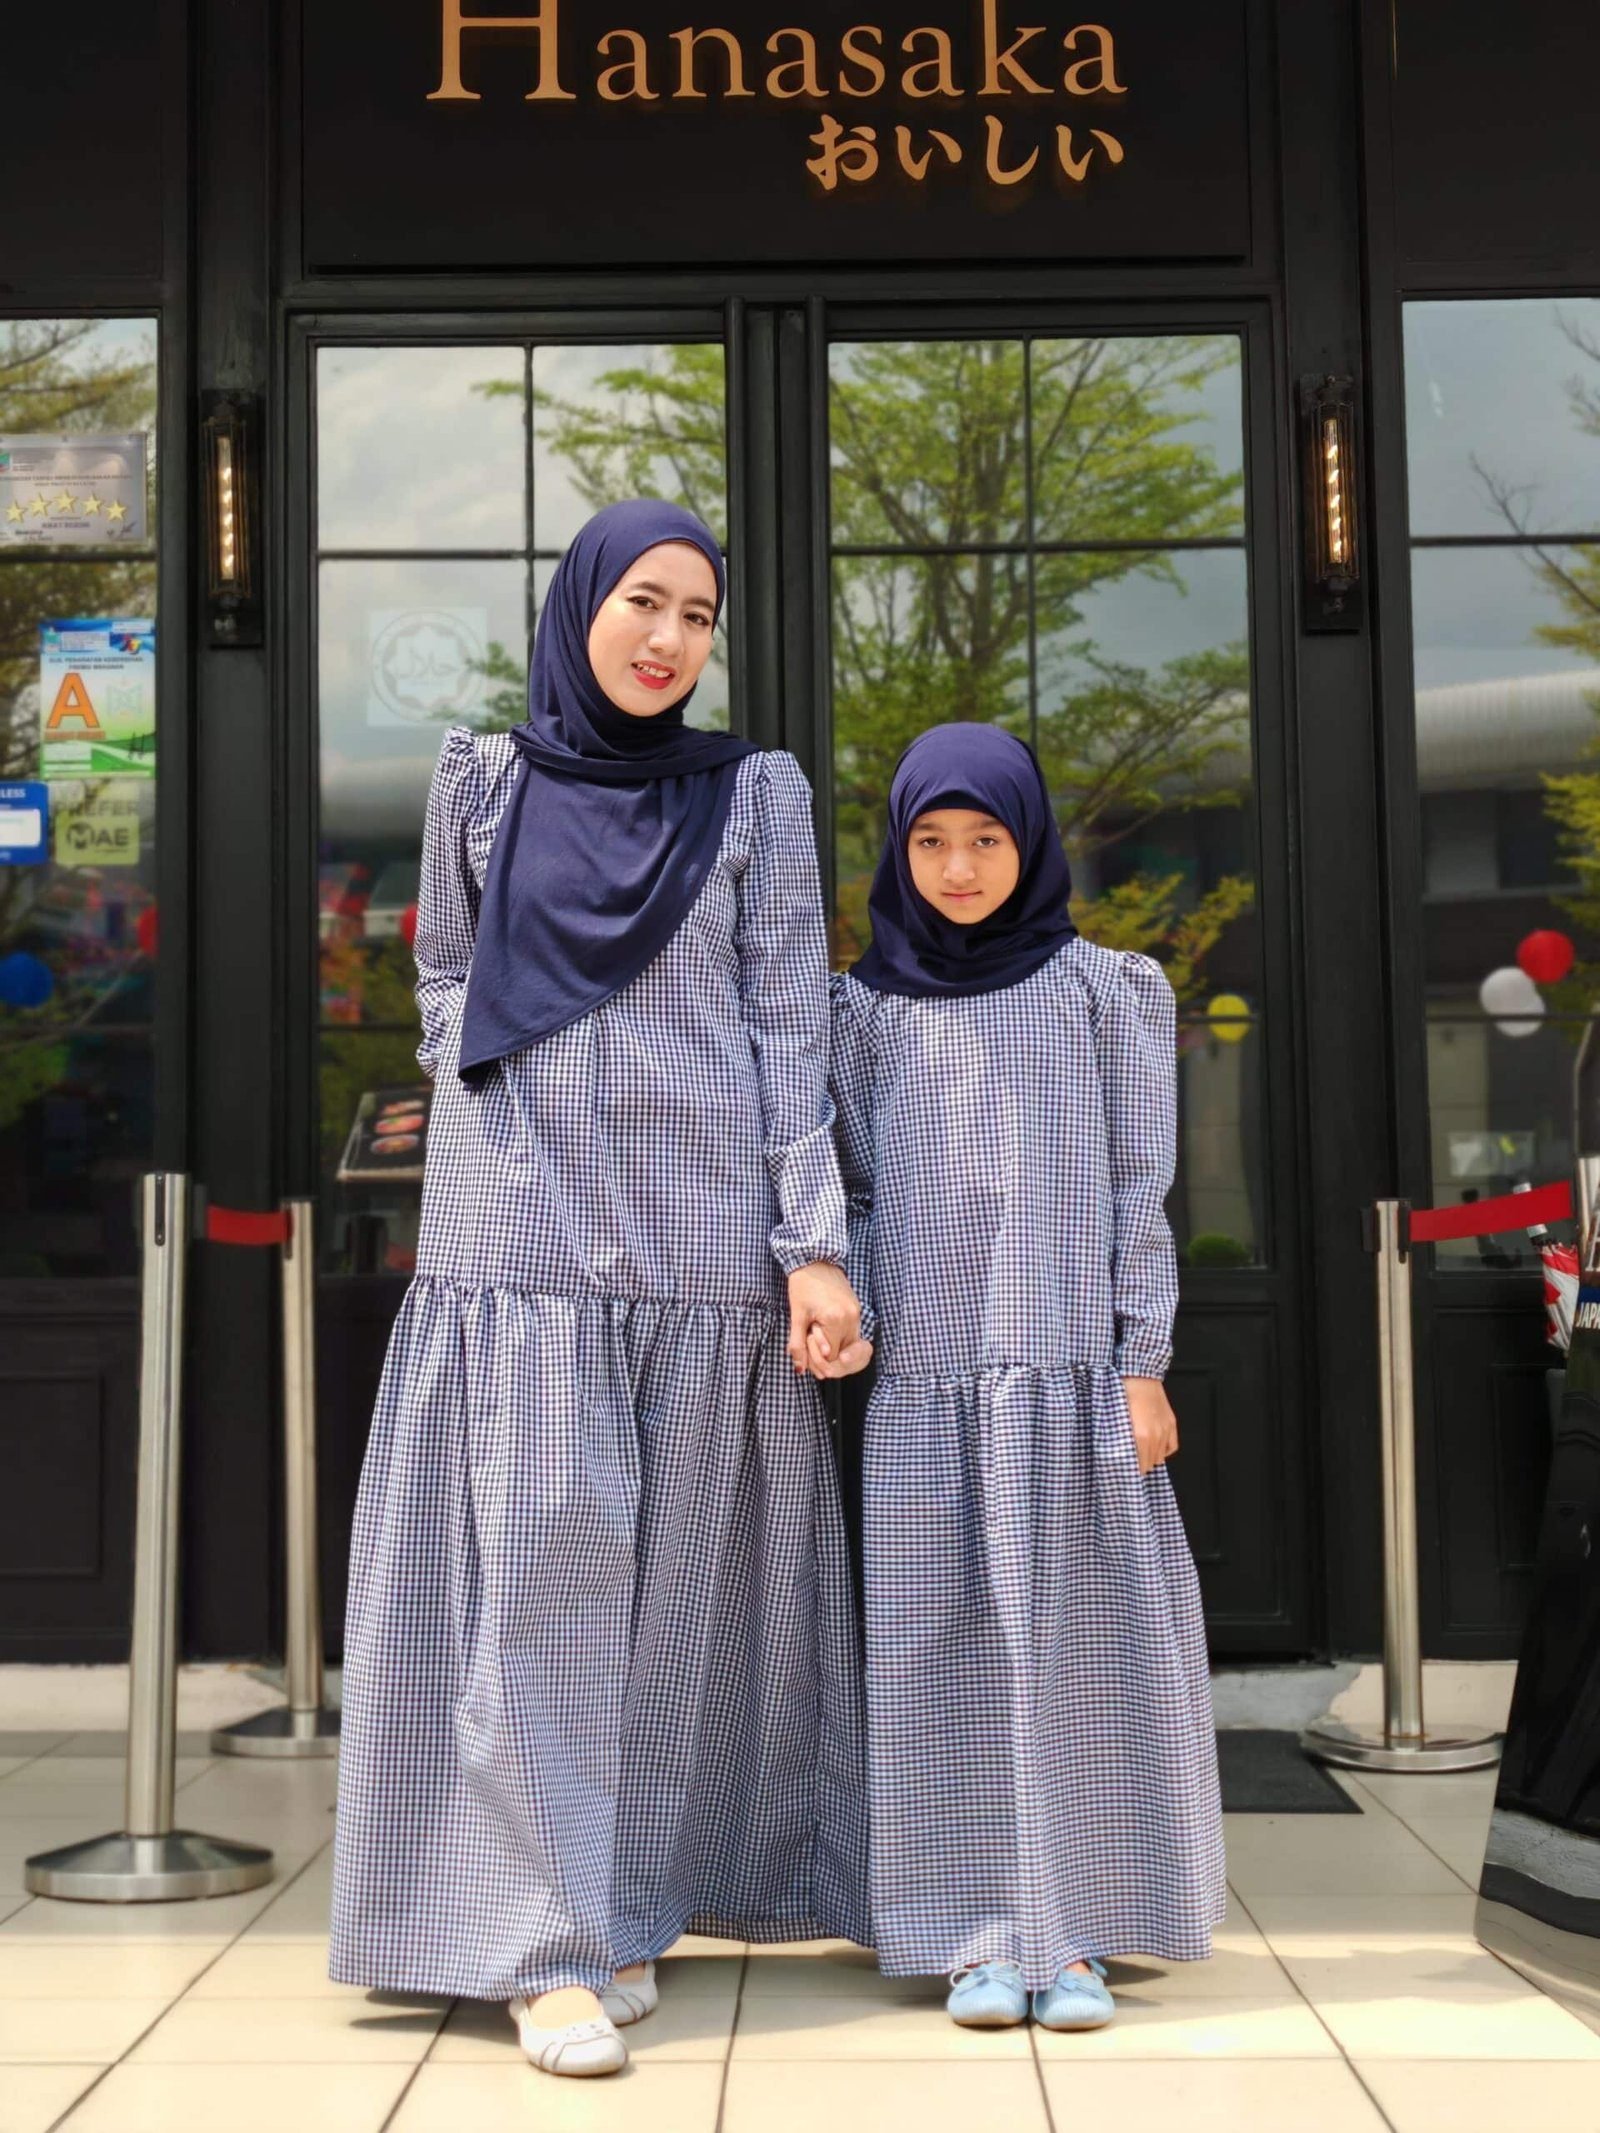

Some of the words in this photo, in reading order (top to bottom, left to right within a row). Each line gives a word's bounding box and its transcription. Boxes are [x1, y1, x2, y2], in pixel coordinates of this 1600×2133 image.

[426, 0, 1128, 100] Hanasaka
[806, 114, 1124, 190] おいしい
[46, 672, 100, 729] A
